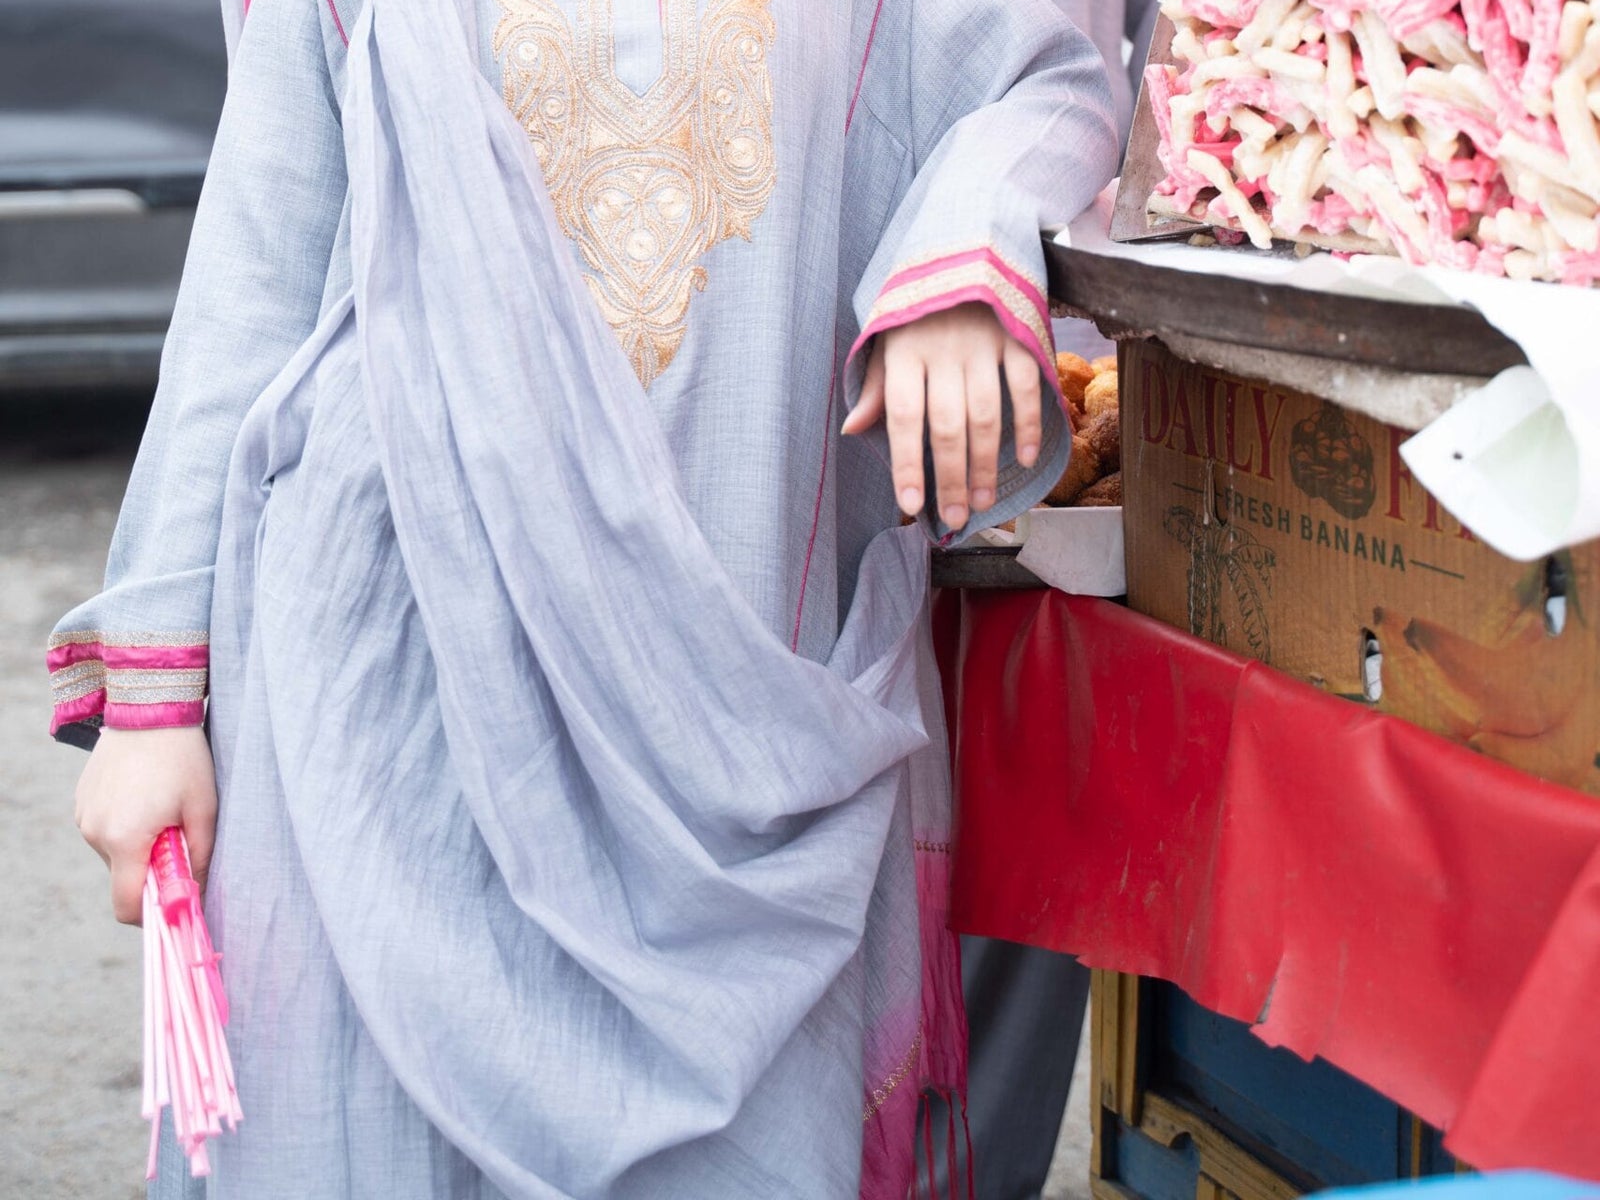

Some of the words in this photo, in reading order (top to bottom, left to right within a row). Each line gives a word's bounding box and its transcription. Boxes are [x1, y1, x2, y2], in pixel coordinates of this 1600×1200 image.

[1140, 358, 1287, 481] DAILY
[1223, 486, 1291, 534] FRESH
[1301, 514, 1406, 572] BANANA
